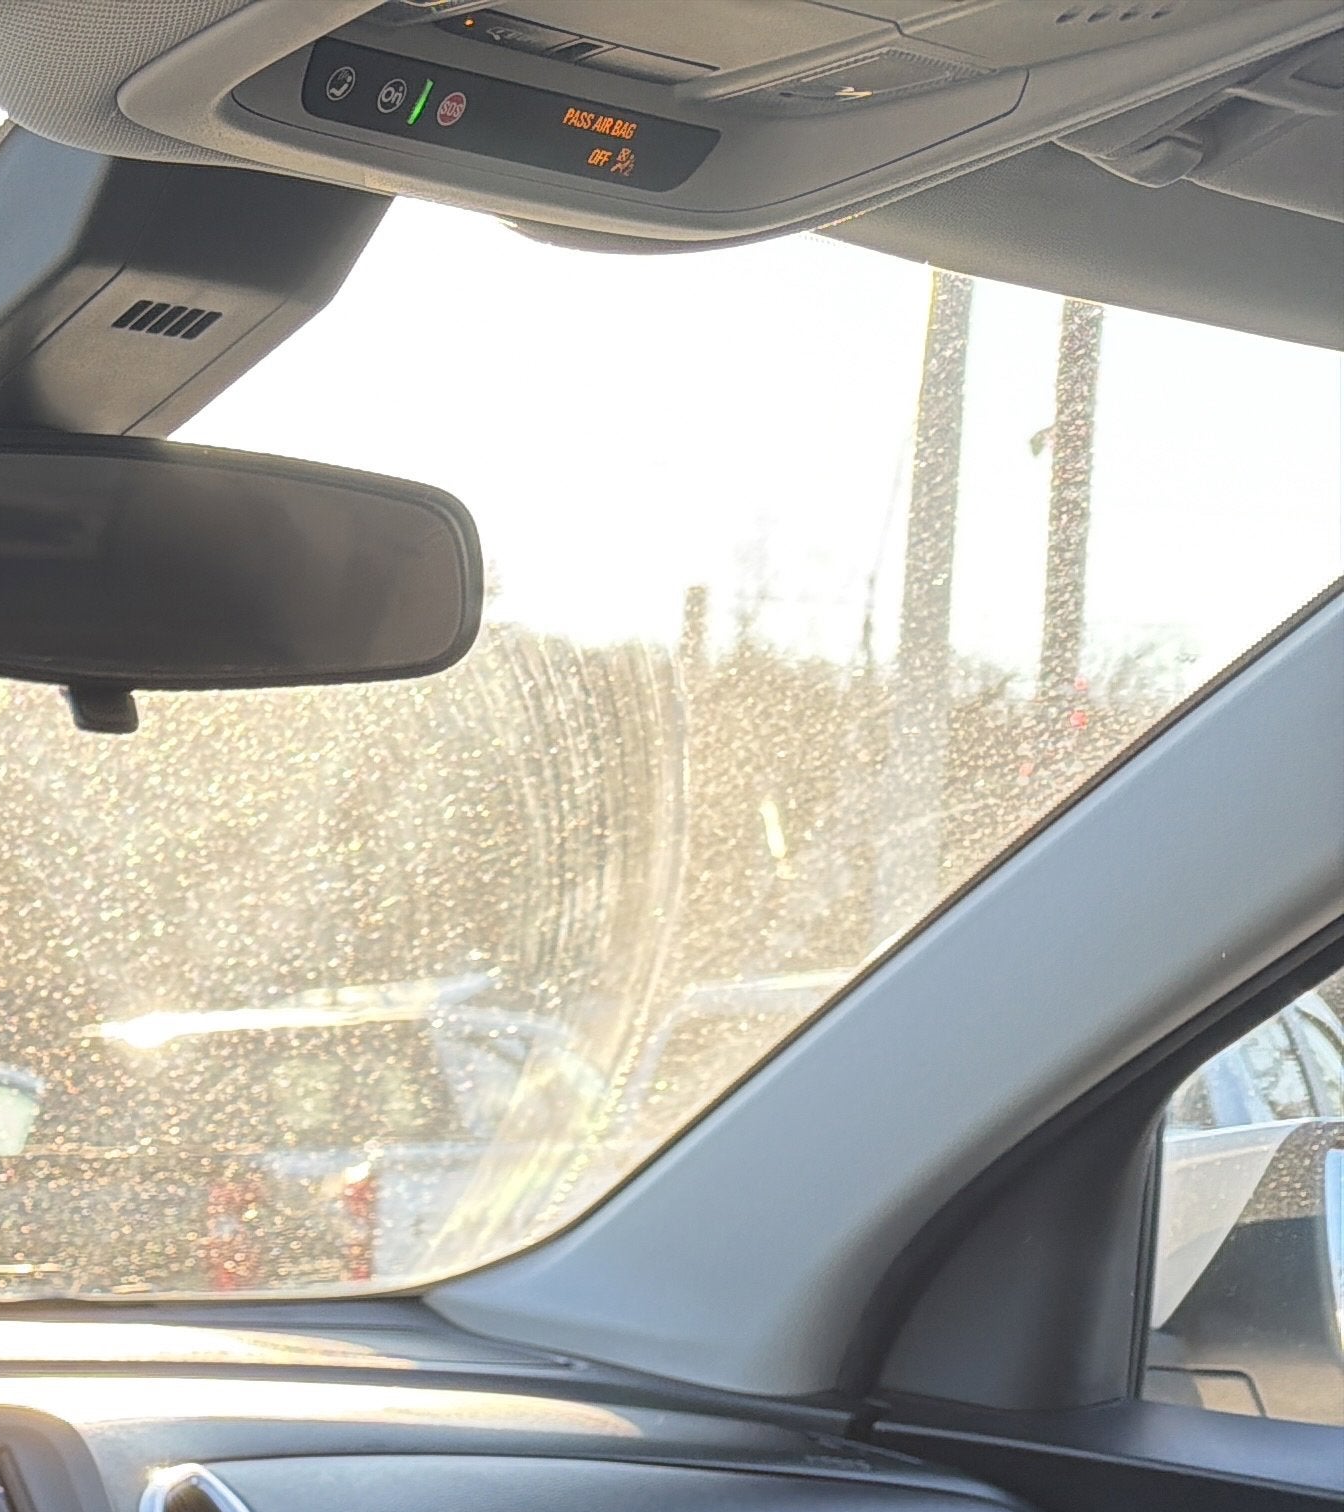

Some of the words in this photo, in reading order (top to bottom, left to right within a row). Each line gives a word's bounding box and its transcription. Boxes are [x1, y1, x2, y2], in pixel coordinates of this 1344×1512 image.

[441, 100, 464, 118] SOS
[562, 107, 595, 130] PASS
[591, 115, 614, 135] AIR
[611, 119, 638, 140] BAG
[587, 147, 613, 167] OFF
